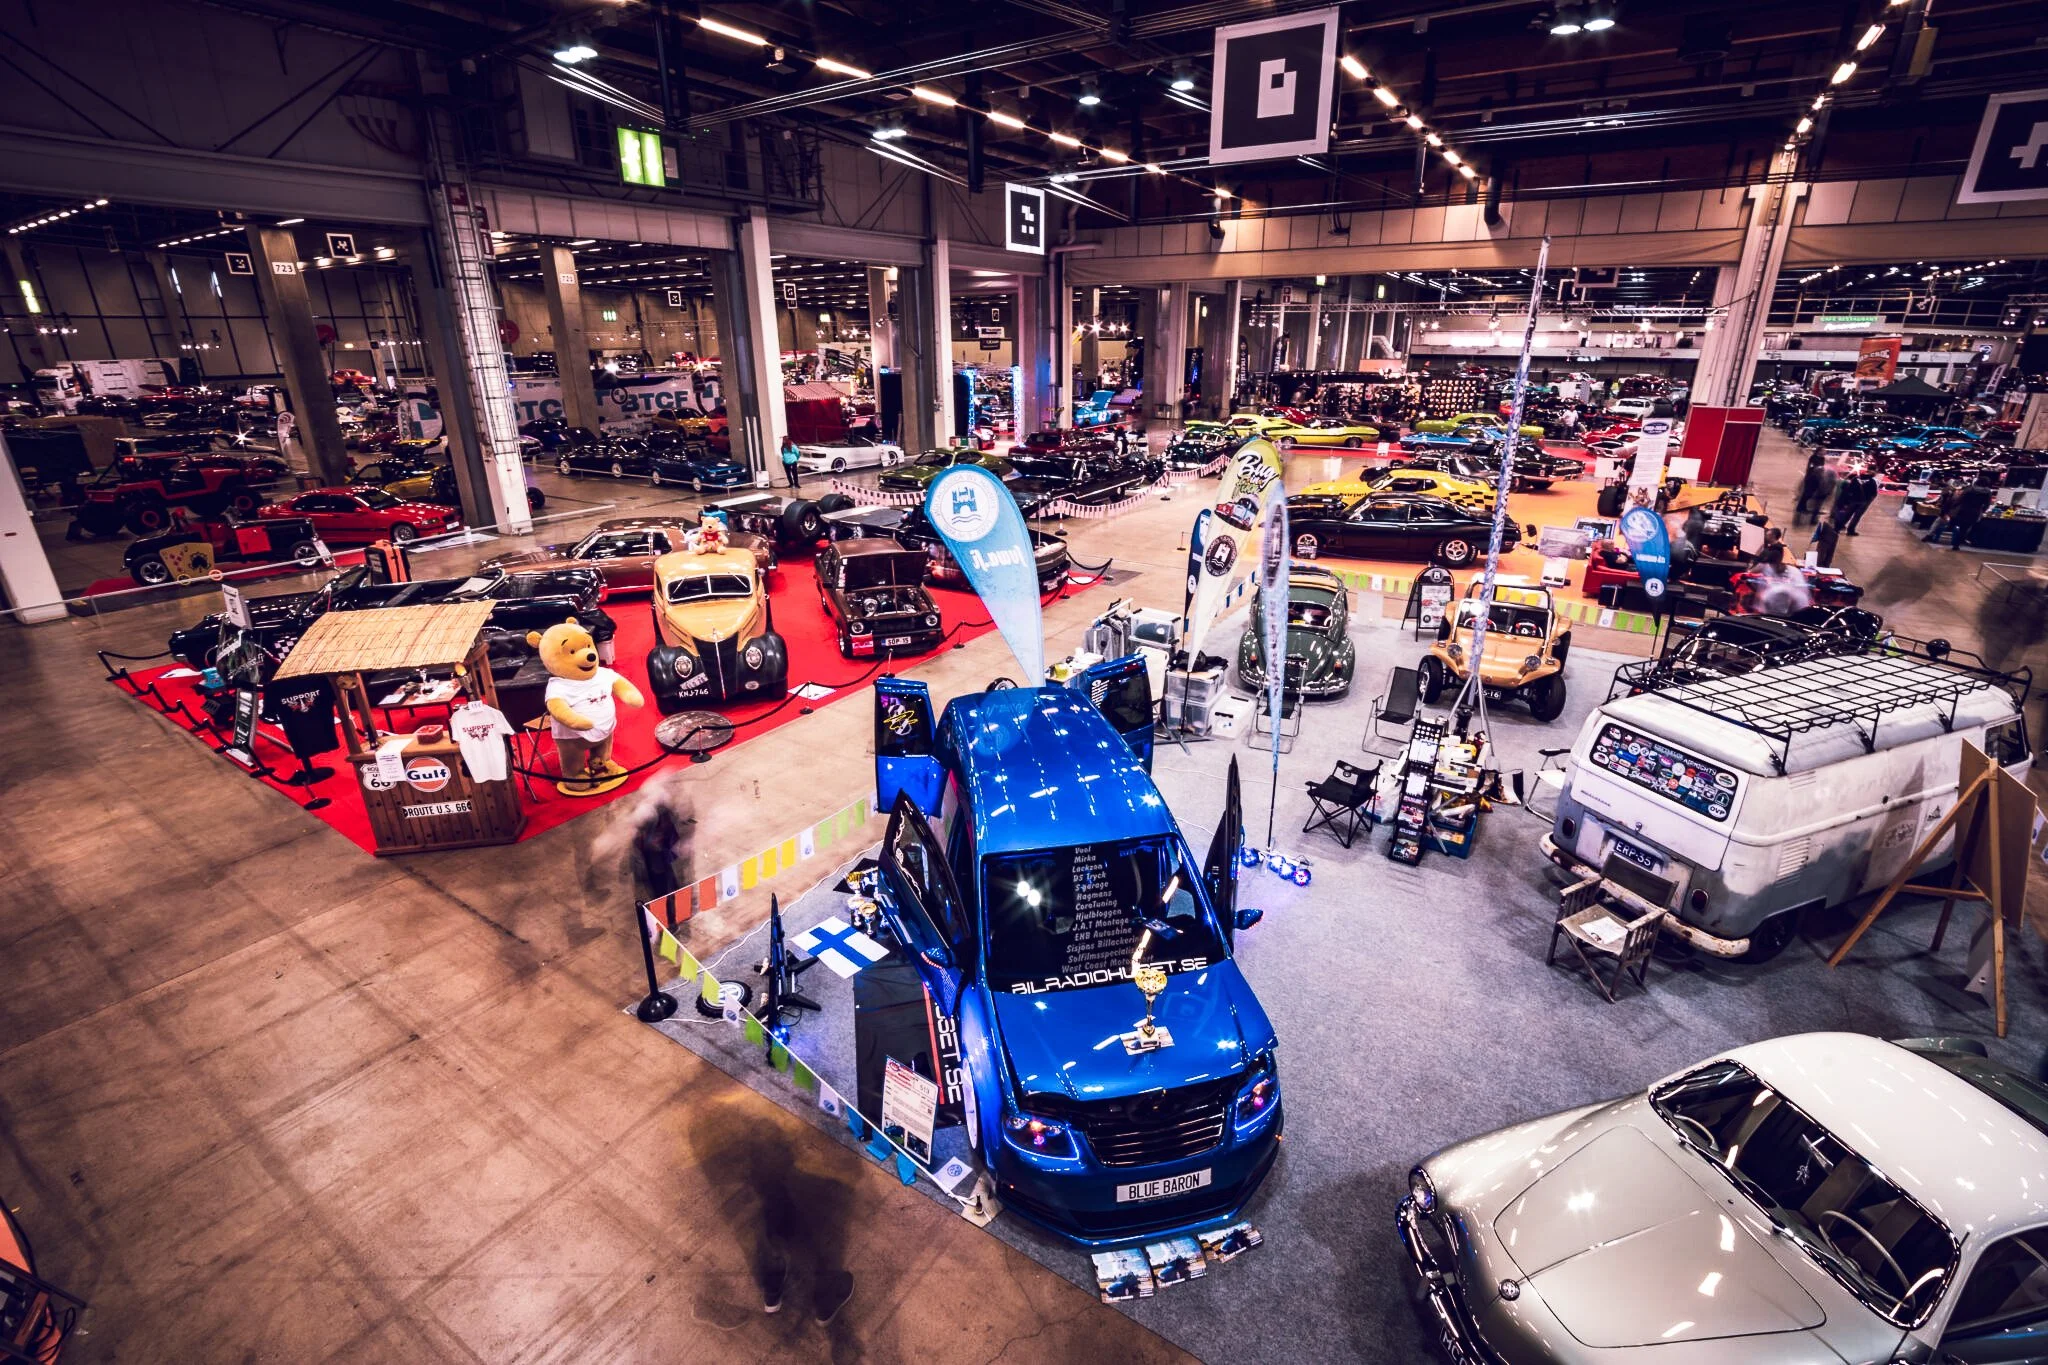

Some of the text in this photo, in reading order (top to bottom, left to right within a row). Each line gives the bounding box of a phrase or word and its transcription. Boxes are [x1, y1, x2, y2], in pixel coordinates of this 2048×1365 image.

[275, 264, 293, 273] 723
[1237, 451, 1280, 493] Bug
[281, 689, 321, 705] SUPPORT
[462, 723, 495, 733] SUPPORT
[406, 768, 447, 781] Gulf
[408, 803, 468, 817] ROUTE U.S. 66
[1709, 806, 1726, 815] OVP
[1074, 854, 1096, 864] Mirka
[1086, 871, 1107, 881] Tryck
[1076, 890, 1113, 901] Hagmans
[1075, 909, 1122, 922] Hjulbloggen
[1095, 918, 1129, 928] Montage
[1093, 925, 1132, 938] Autoshine
[1062, 964, 1082, 973] West
[1084, 960, 1107, 970] Coast
[1128, 1181, 1160, 1200] BLUE
[1163, 1173, 1200, 1194] BARON
